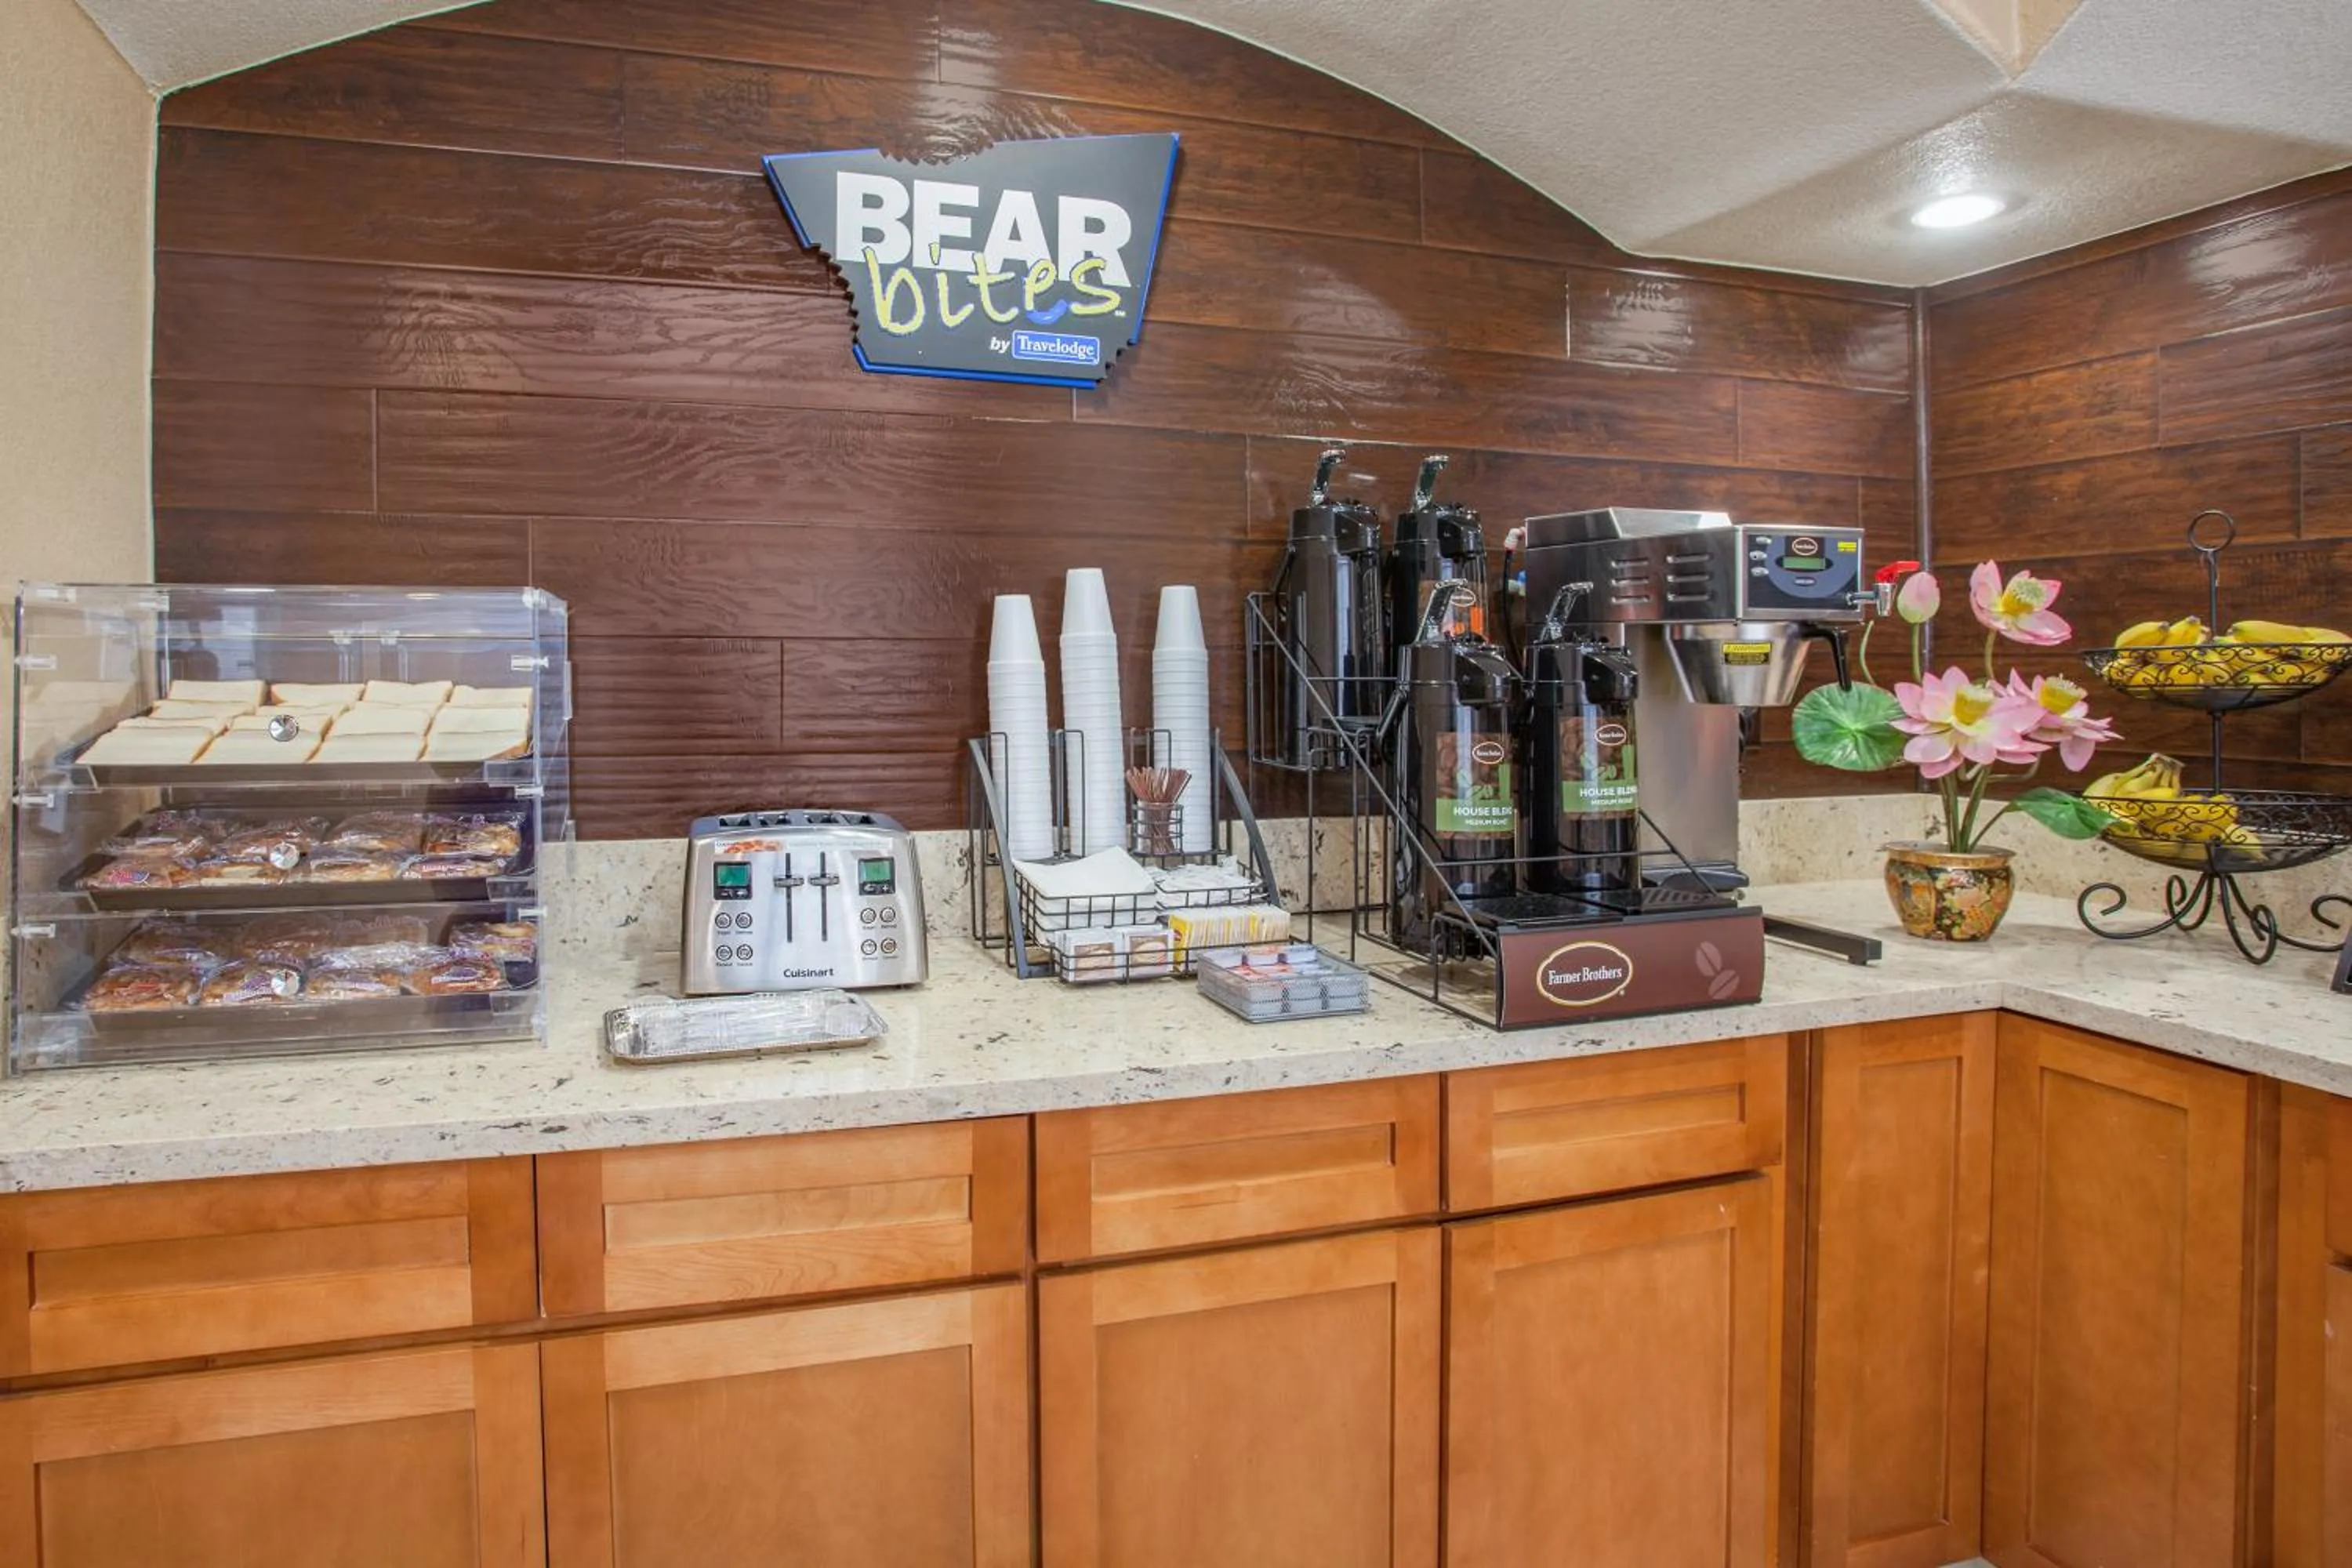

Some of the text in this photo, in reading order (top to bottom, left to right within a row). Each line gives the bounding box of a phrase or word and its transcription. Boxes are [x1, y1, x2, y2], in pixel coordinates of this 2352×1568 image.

[835, 170, 1132, 288] BEAR
[862, 241, 1121, 334] bites
[989, 335, 1095, 359] by Travelodge
[1580, 786, 1616, 797] HOUSE
[1453, 806, 1490, 816] HOUSE
[783, 968, 834, 978] Cuisinart
[1548, 965, 1622, 985] Farmer Brothers
